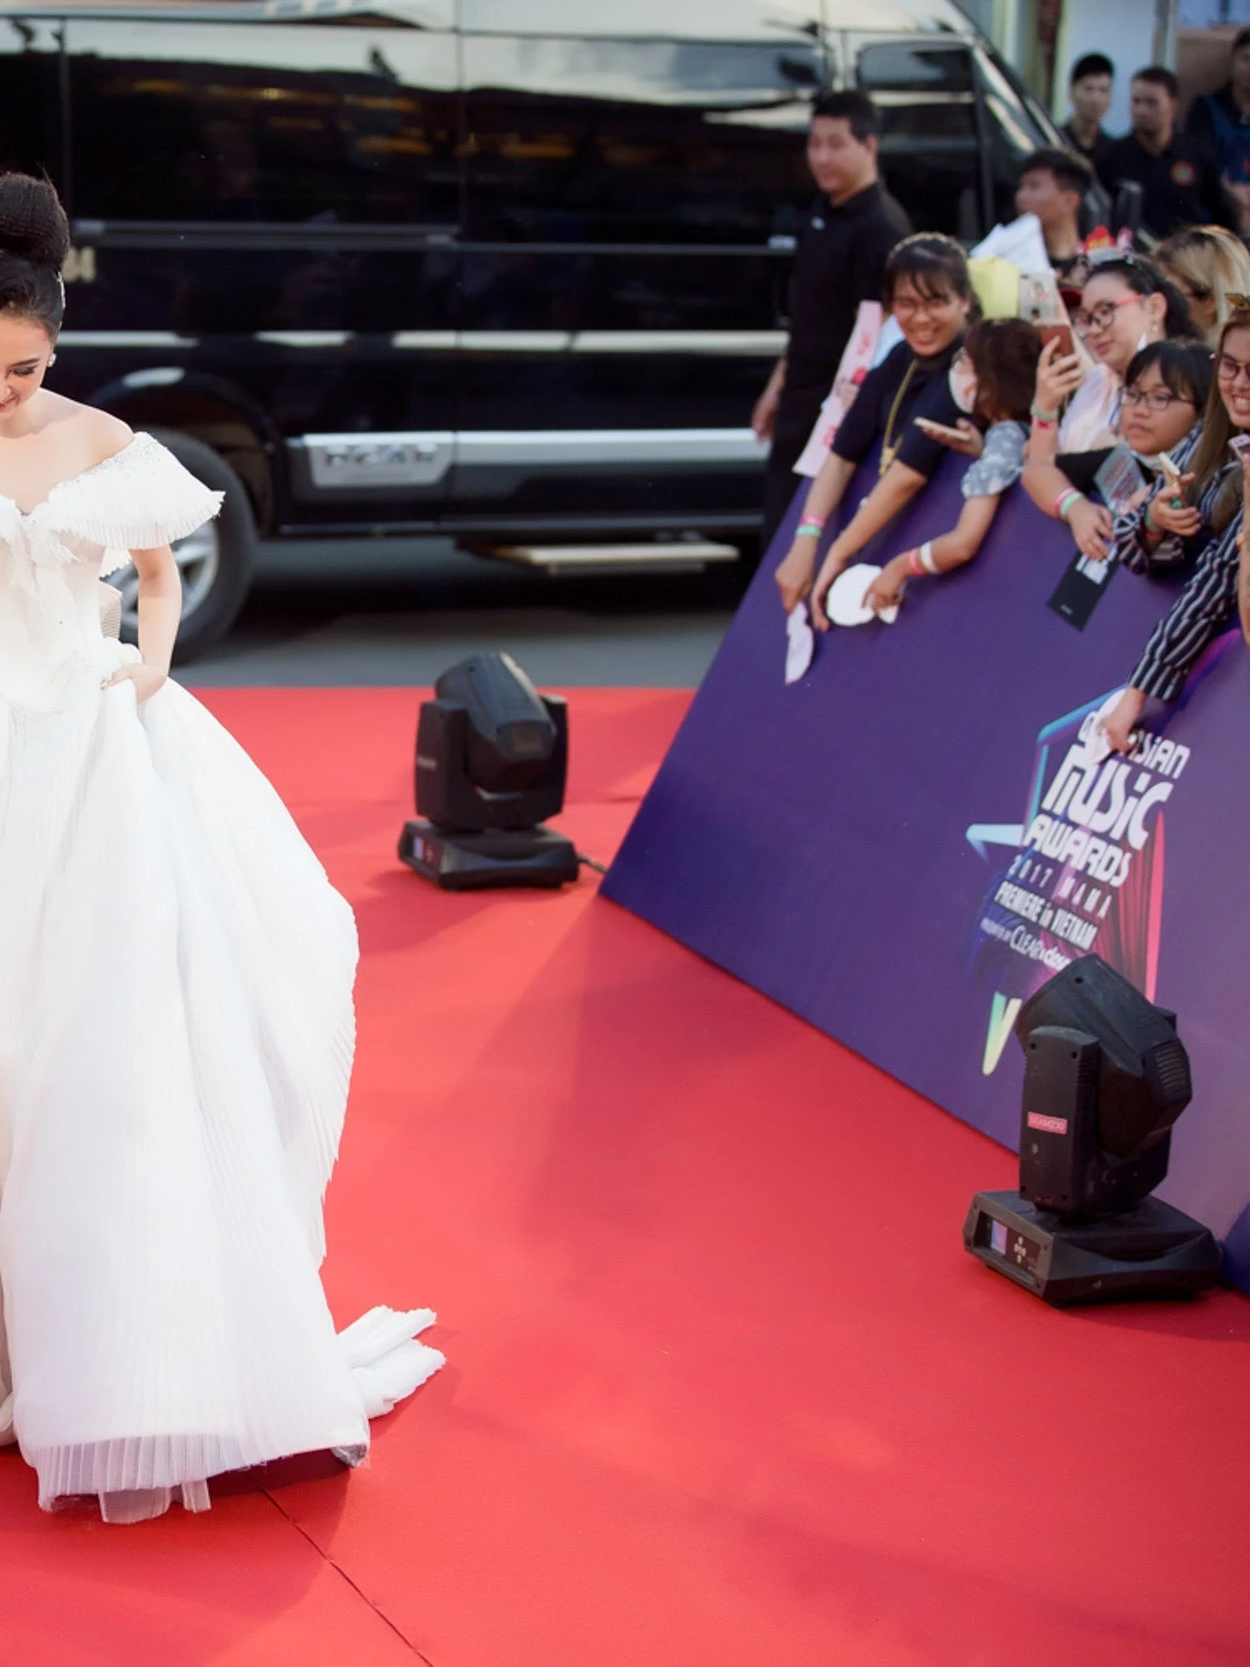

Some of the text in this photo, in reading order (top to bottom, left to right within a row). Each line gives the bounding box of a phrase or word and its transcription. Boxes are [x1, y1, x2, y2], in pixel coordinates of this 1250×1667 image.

[1022, 813, 1132, 887] AWARDS
[994, 881, 1046, 923] PREMIERE
[1051, 908, 1098, 951] VIETNAM
[1008, 854, 1112, 920] 2017 MAMA
